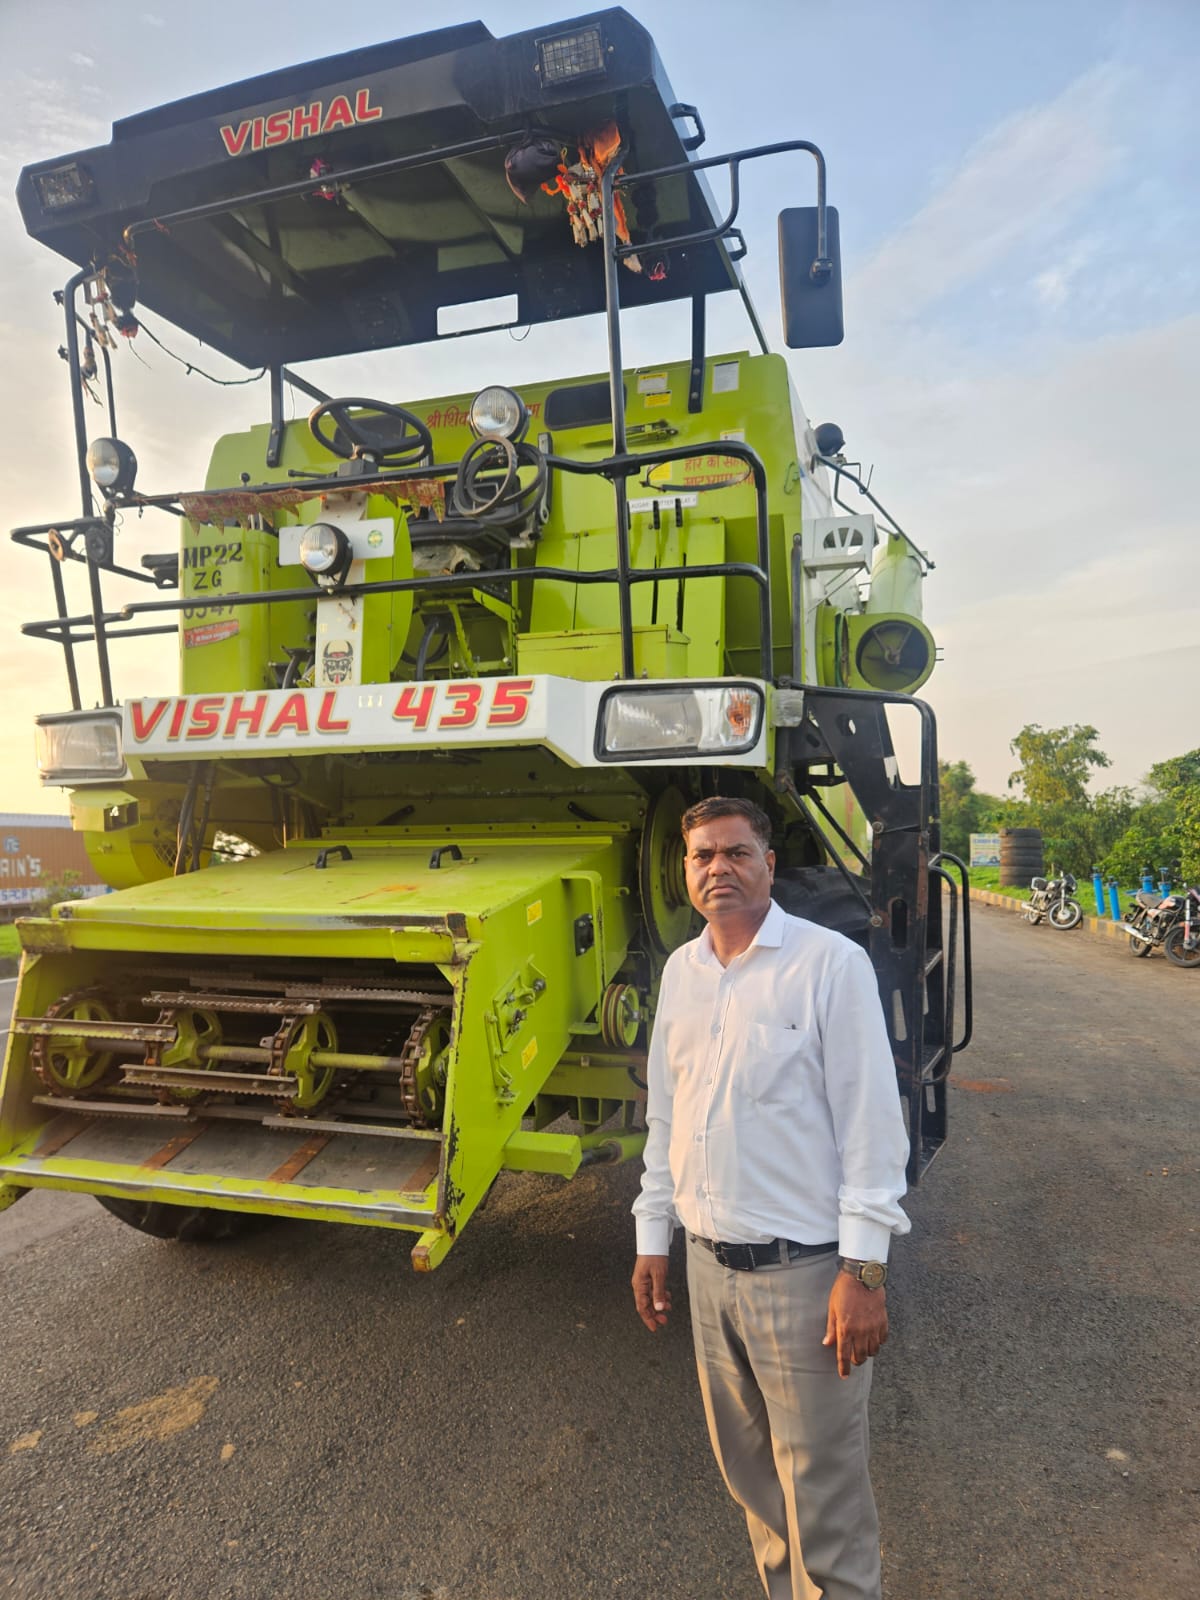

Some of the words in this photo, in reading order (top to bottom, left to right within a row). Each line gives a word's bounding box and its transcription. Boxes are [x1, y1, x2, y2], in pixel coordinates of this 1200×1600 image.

[220, 89, 382, 156] VISHAL
[183, 542, 244, 568] MP22
[130, 690, 350, 743] VISHAL
[392, 678, 535, 733] 435
